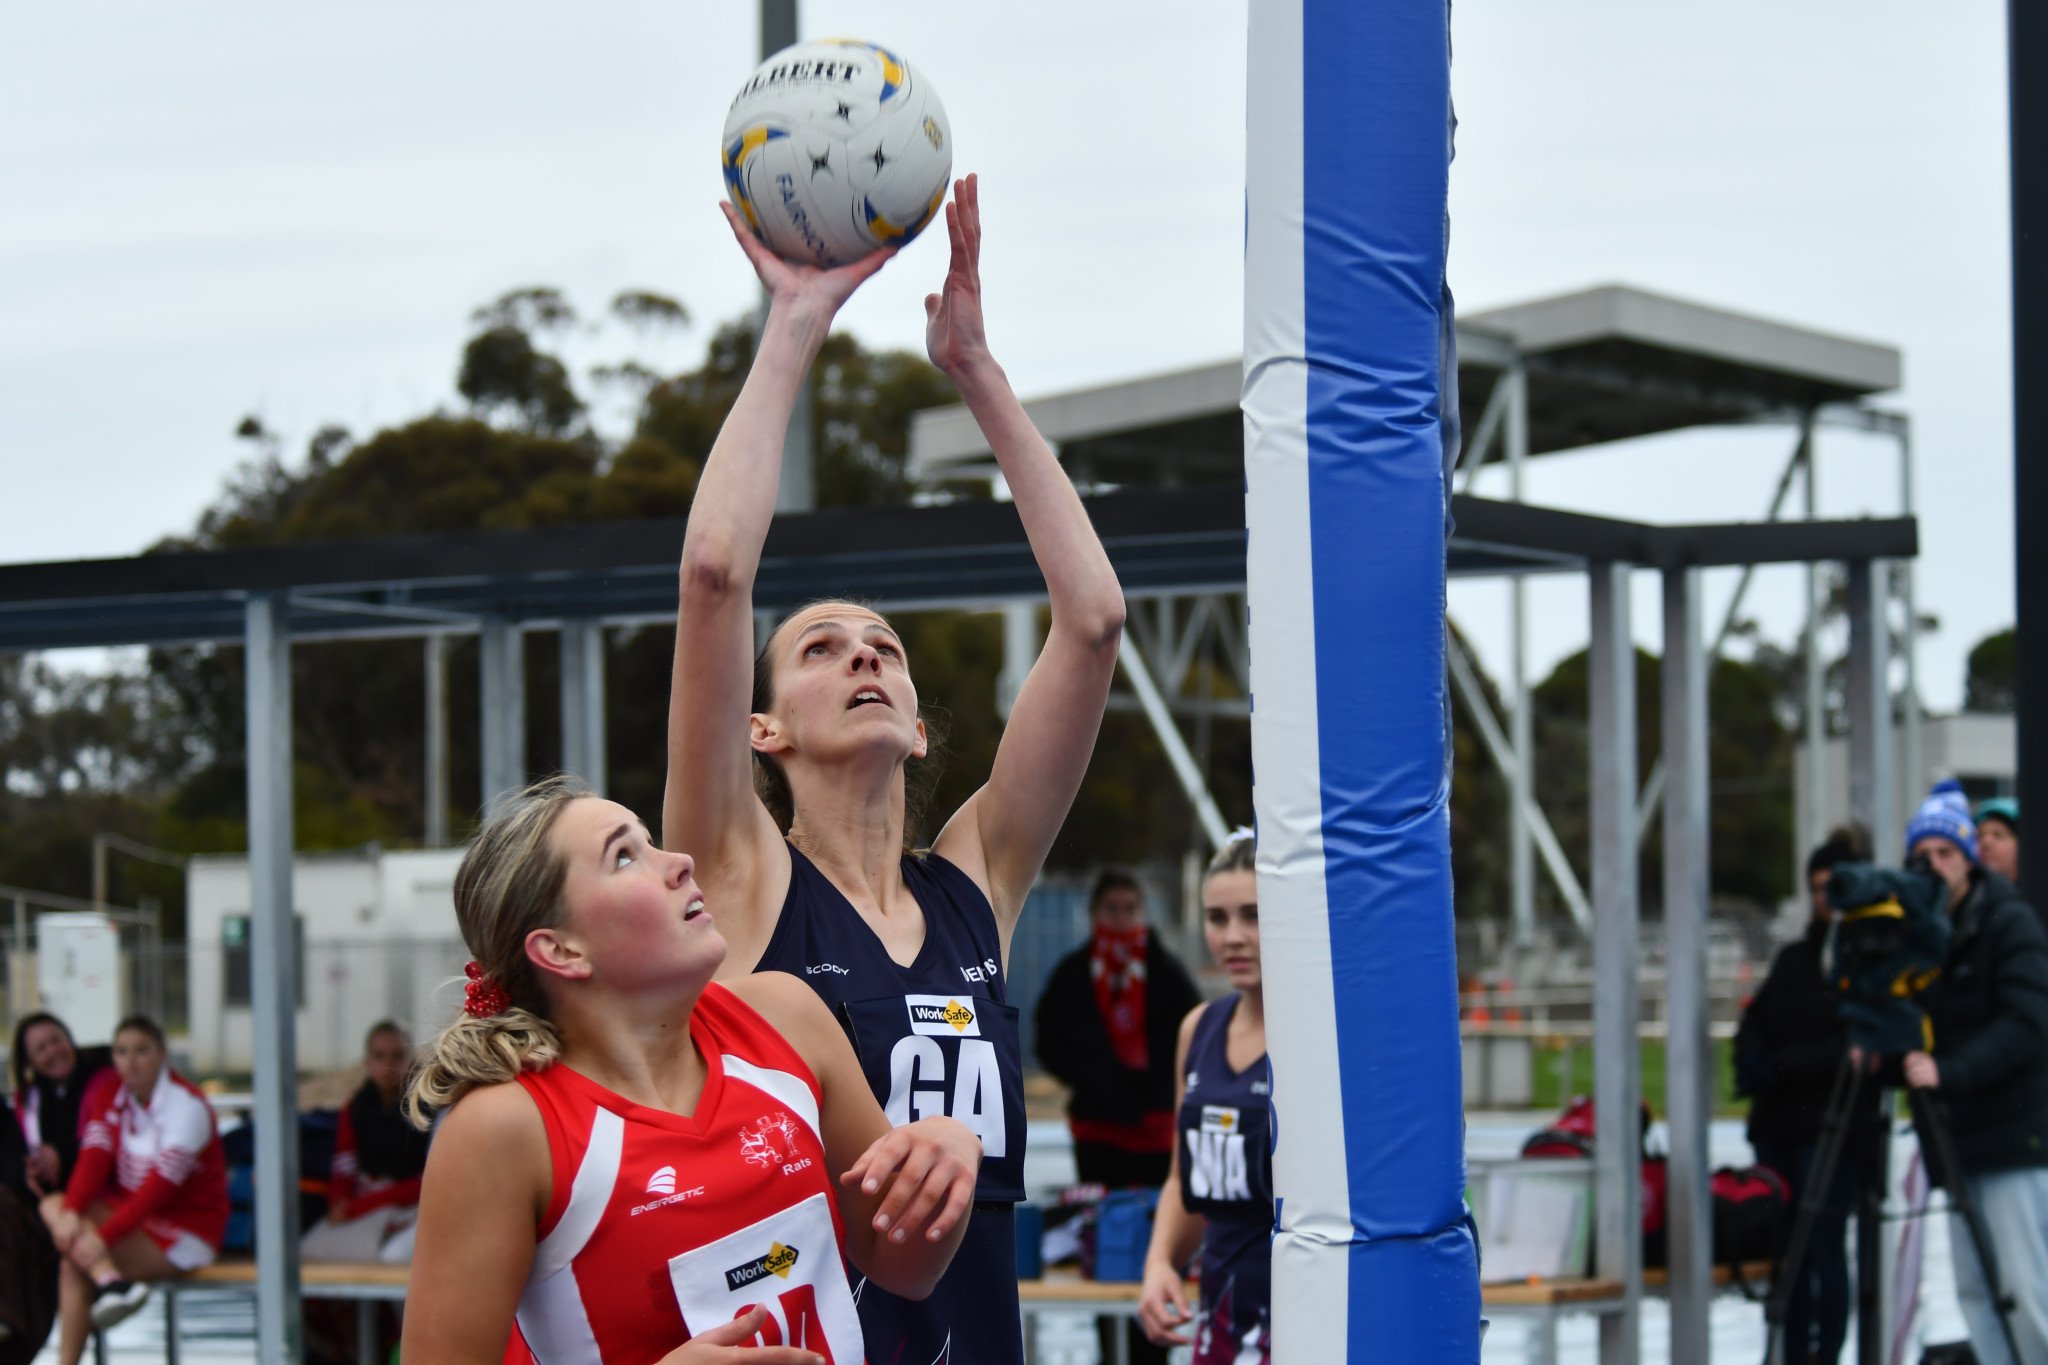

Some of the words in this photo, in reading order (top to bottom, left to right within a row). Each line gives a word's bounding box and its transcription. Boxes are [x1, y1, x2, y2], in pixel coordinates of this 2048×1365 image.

[806, 963, 850, 976] SCODY
[884, 1035, 1006, 1158] GA
[782, 1157, 812, 1176] Rats
[1186, 1128, 1252, 1200] WA
[630, 1185, 705, 1217] ENERGETIC
